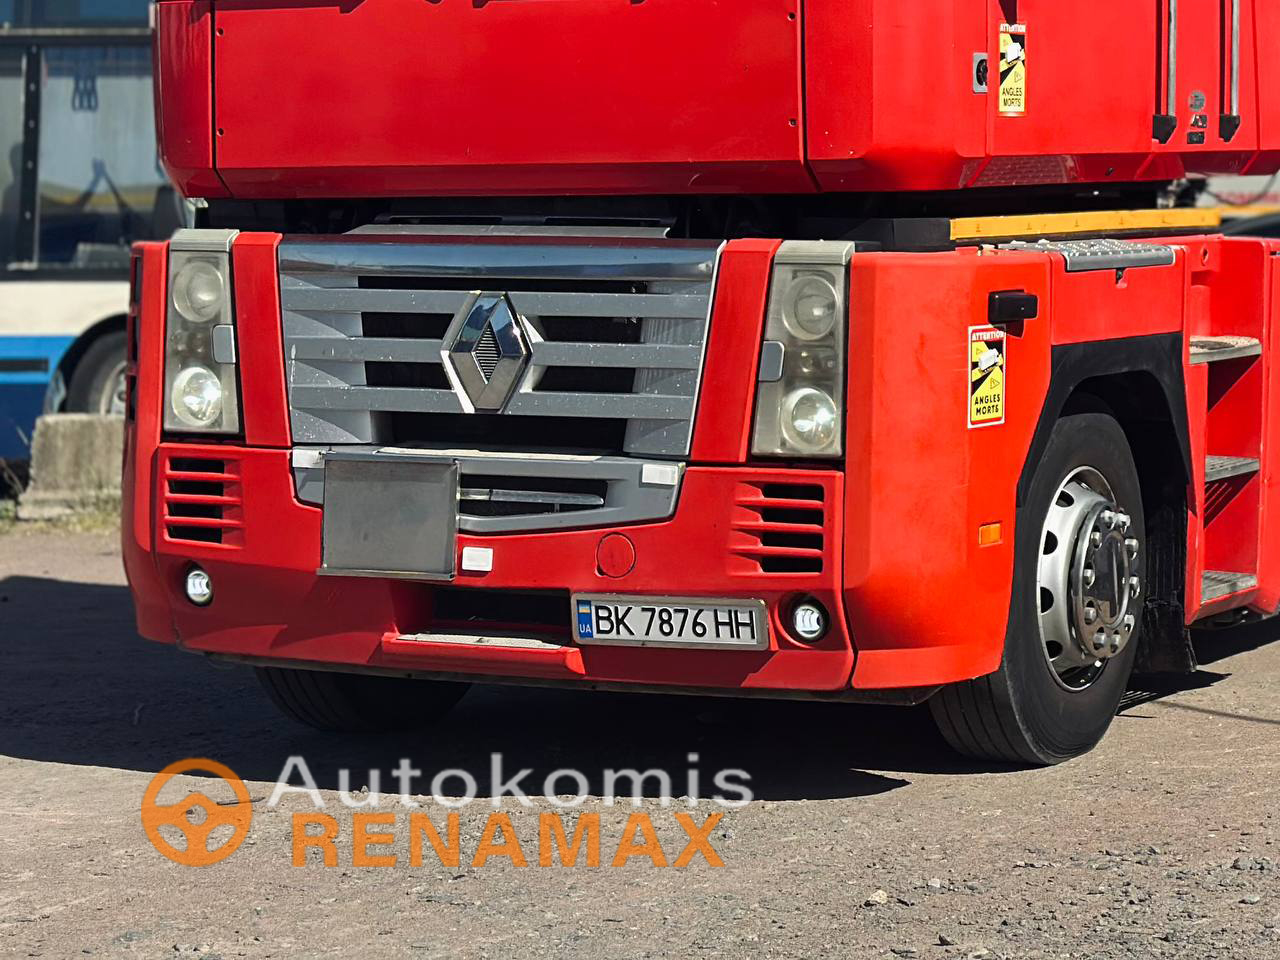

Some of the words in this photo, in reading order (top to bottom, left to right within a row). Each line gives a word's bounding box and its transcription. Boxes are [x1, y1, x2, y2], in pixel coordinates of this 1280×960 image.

[1001, 87, 1023, 97] ANGLES
[1003, 97, 1022, 107] MORTS
[975, 393, 1001, 406] ANGLES
[976, 404, 999, 416] MORTS
[641, 607, 707, 638] 7876
[579, 623, 592, 634] UA
